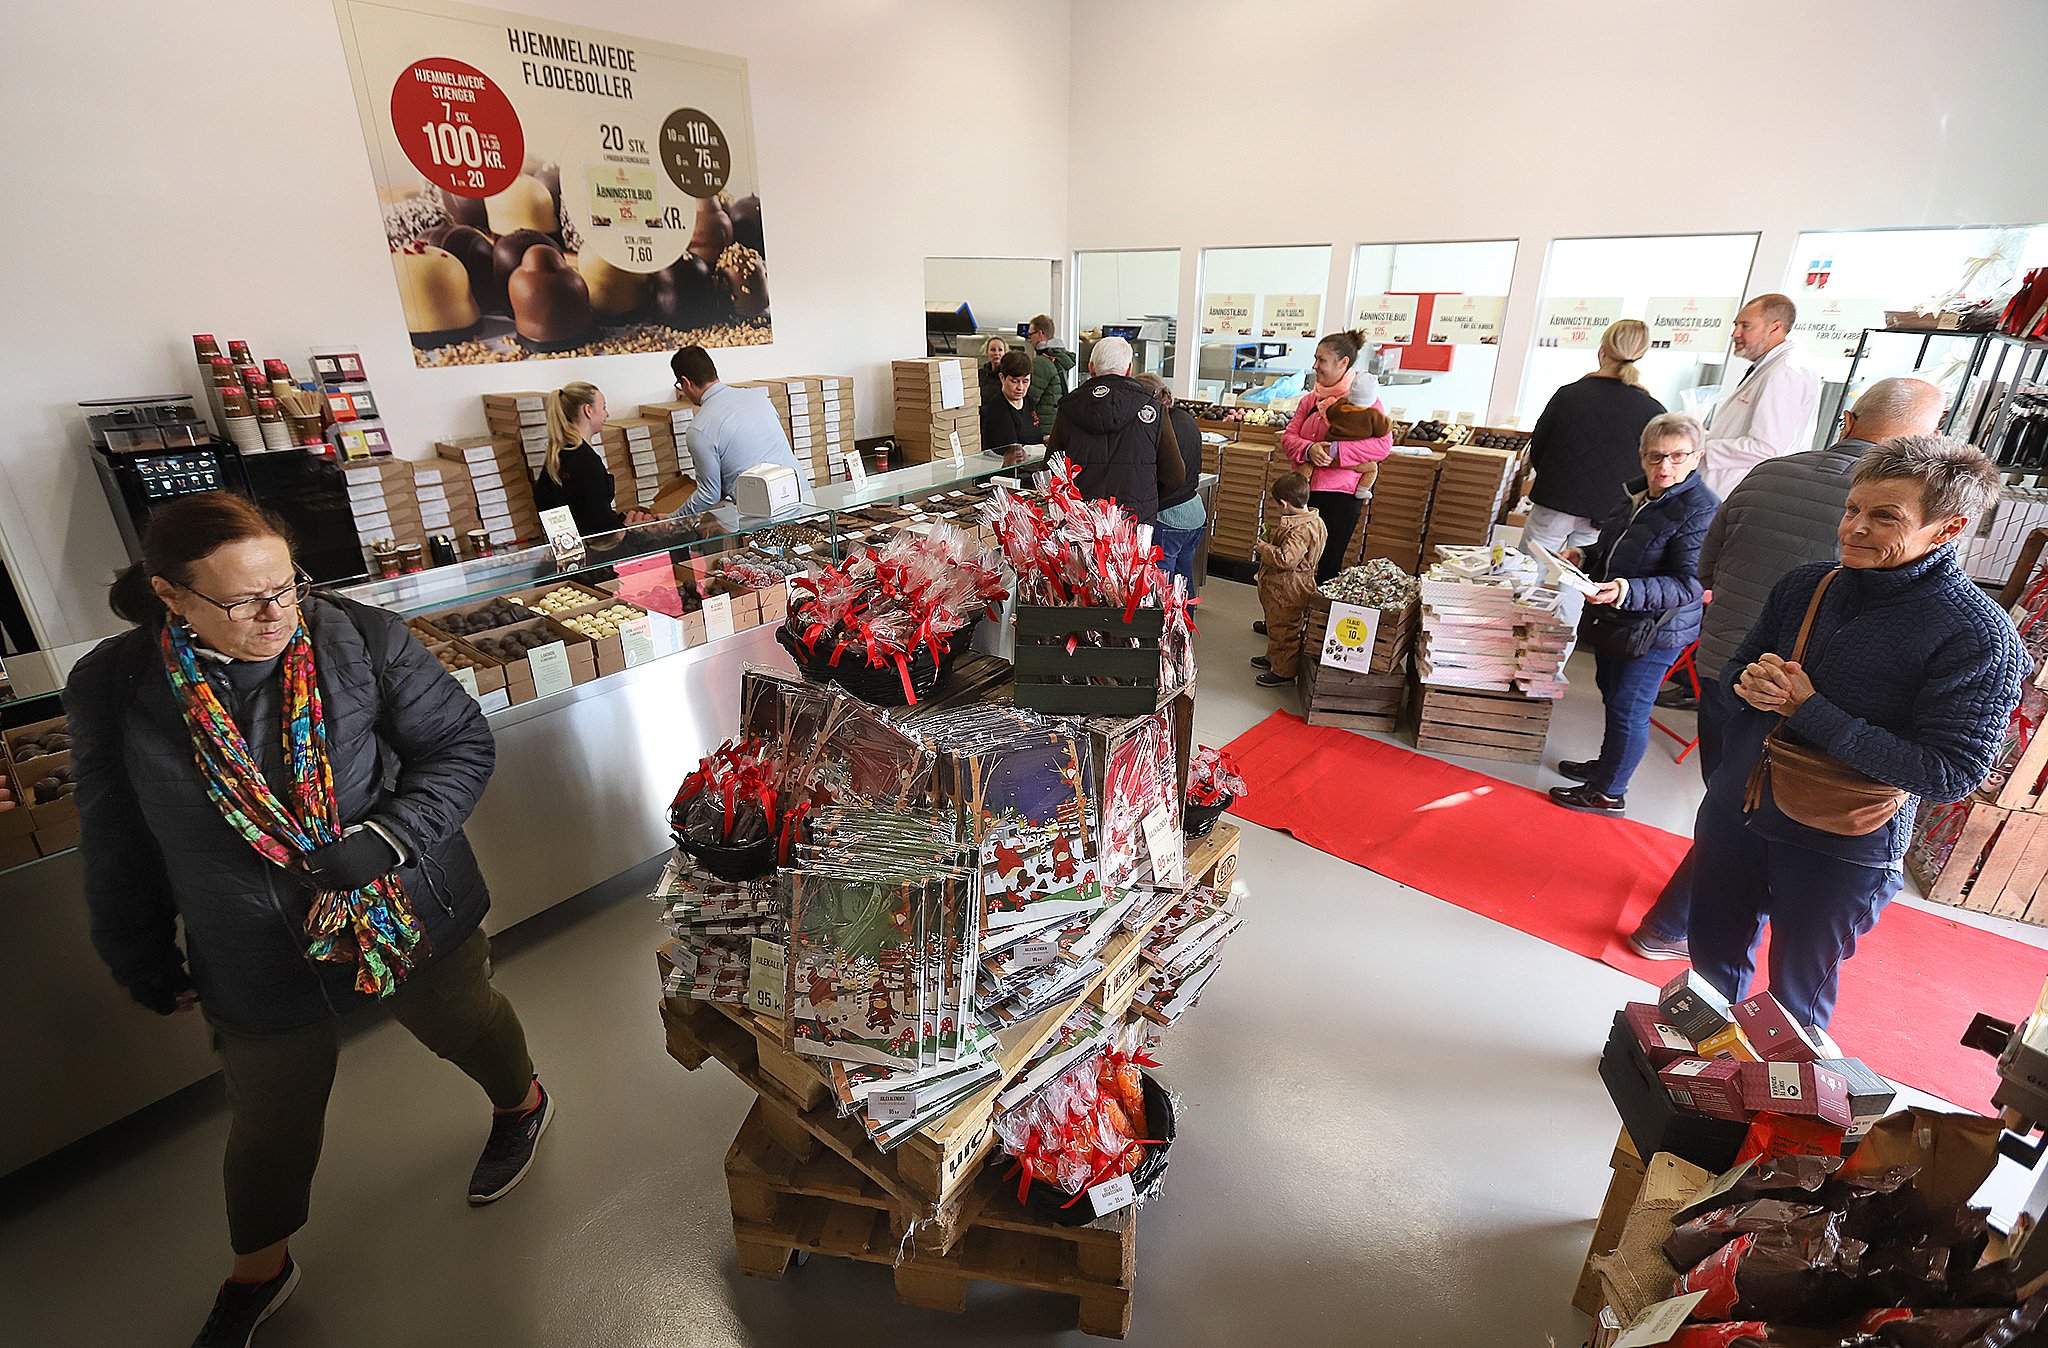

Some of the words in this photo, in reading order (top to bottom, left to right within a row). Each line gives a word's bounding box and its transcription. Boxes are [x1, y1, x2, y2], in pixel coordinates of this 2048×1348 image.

[507, 27, 637, 73] HJEMMELAVEDE
[414, 67, 486, 91] HJEMMELAVEDE
[522, 60, 633, 100] FLØDEBOLLER
[432, 85, 477, 104] STÆNGER
[441, 101, 451, 121] 7
[600, 124, 624, 151] 20
[628, 138, 648, 153] STK.
[667, 128, 677, 142] 10
[687, 120, 709, 147] 110
[421, 121, 483, 168] 100
[483, 150, 506, 169] KR.
[675, 153, 682, 167] 6
[695, 147, 711, 169] 75
[450, 173, 457, 187] 1
[467, 170, 485, 189] 20
[681, 173, 685, 184] 1
[704, 172, 712, 186] 17
[628, 246, 653, 263] 7,60
[1348, 630, 1358, 640] 10
[757, 989, 771, 1008] 95
